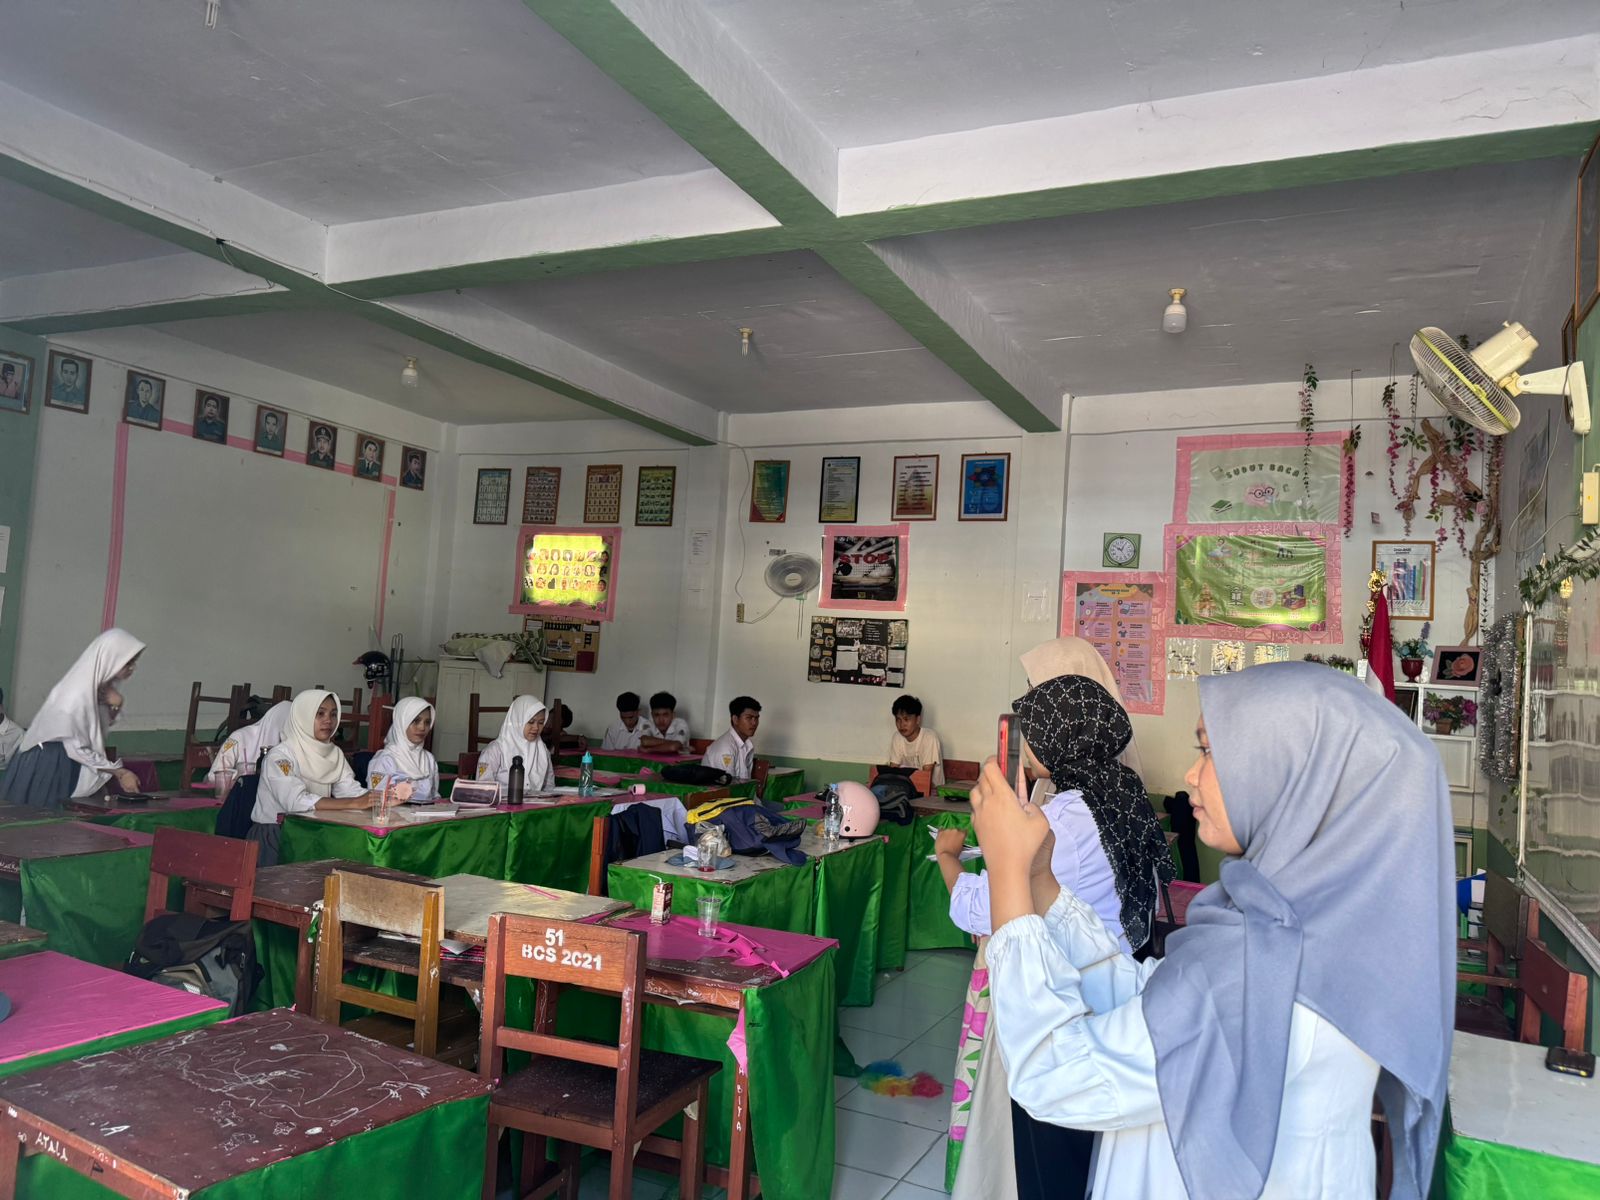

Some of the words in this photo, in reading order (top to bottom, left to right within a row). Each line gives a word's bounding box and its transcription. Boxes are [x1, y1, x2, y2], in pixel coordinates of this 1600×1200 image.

[1225, 463, 1264, 479] SUDUT
[1269, 463, 1300, 478] BACA
[545, 927, 564, 947] 51
